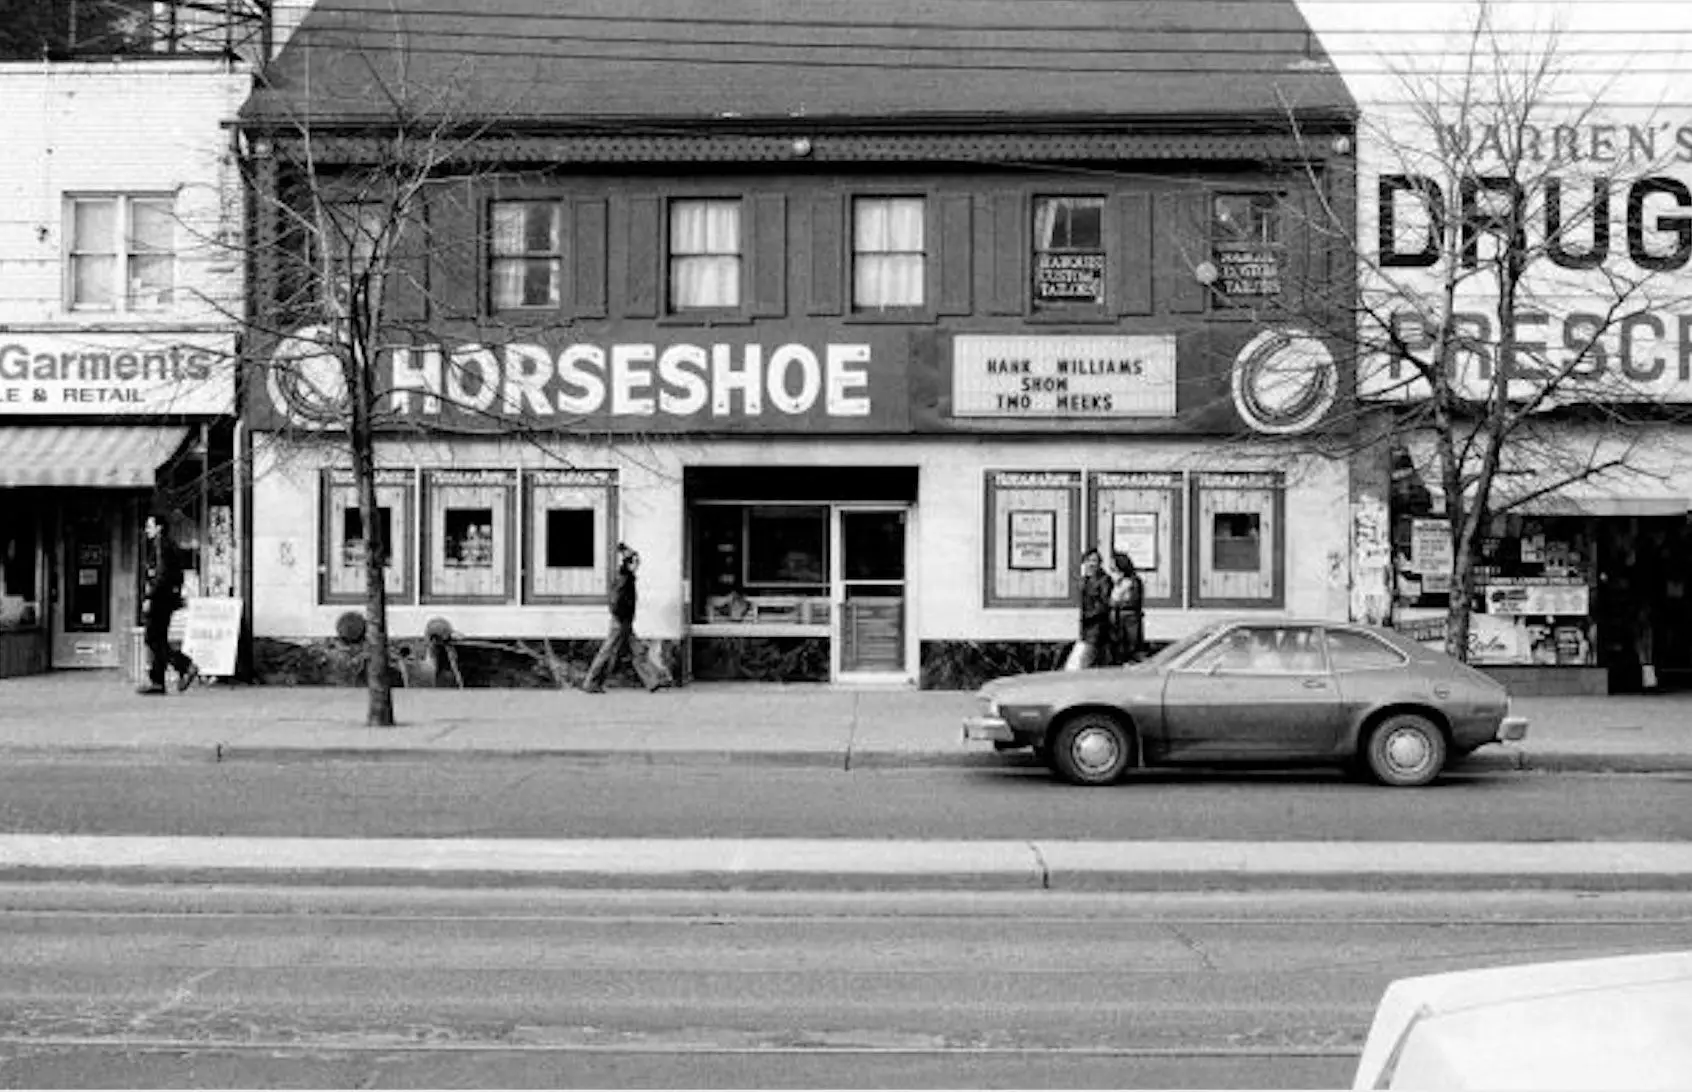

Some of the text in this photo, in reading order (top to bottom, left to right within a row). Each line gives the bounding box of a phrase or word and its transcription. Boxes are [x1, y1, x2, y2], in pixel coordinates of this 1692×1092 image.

[1390, 311, 1692, 381] PRESC
[0, 344, 211, 381] Garments
[987, 358, 1144, 375] HANK WILLIAMS
[391, 343, 872, 416] HORSESHOE
[1020, 376, 1068, 392] SHOW
[0, 388, 146, 402] E & RETAIL
[996, 393, 1113, 411] TWO WEEKS
